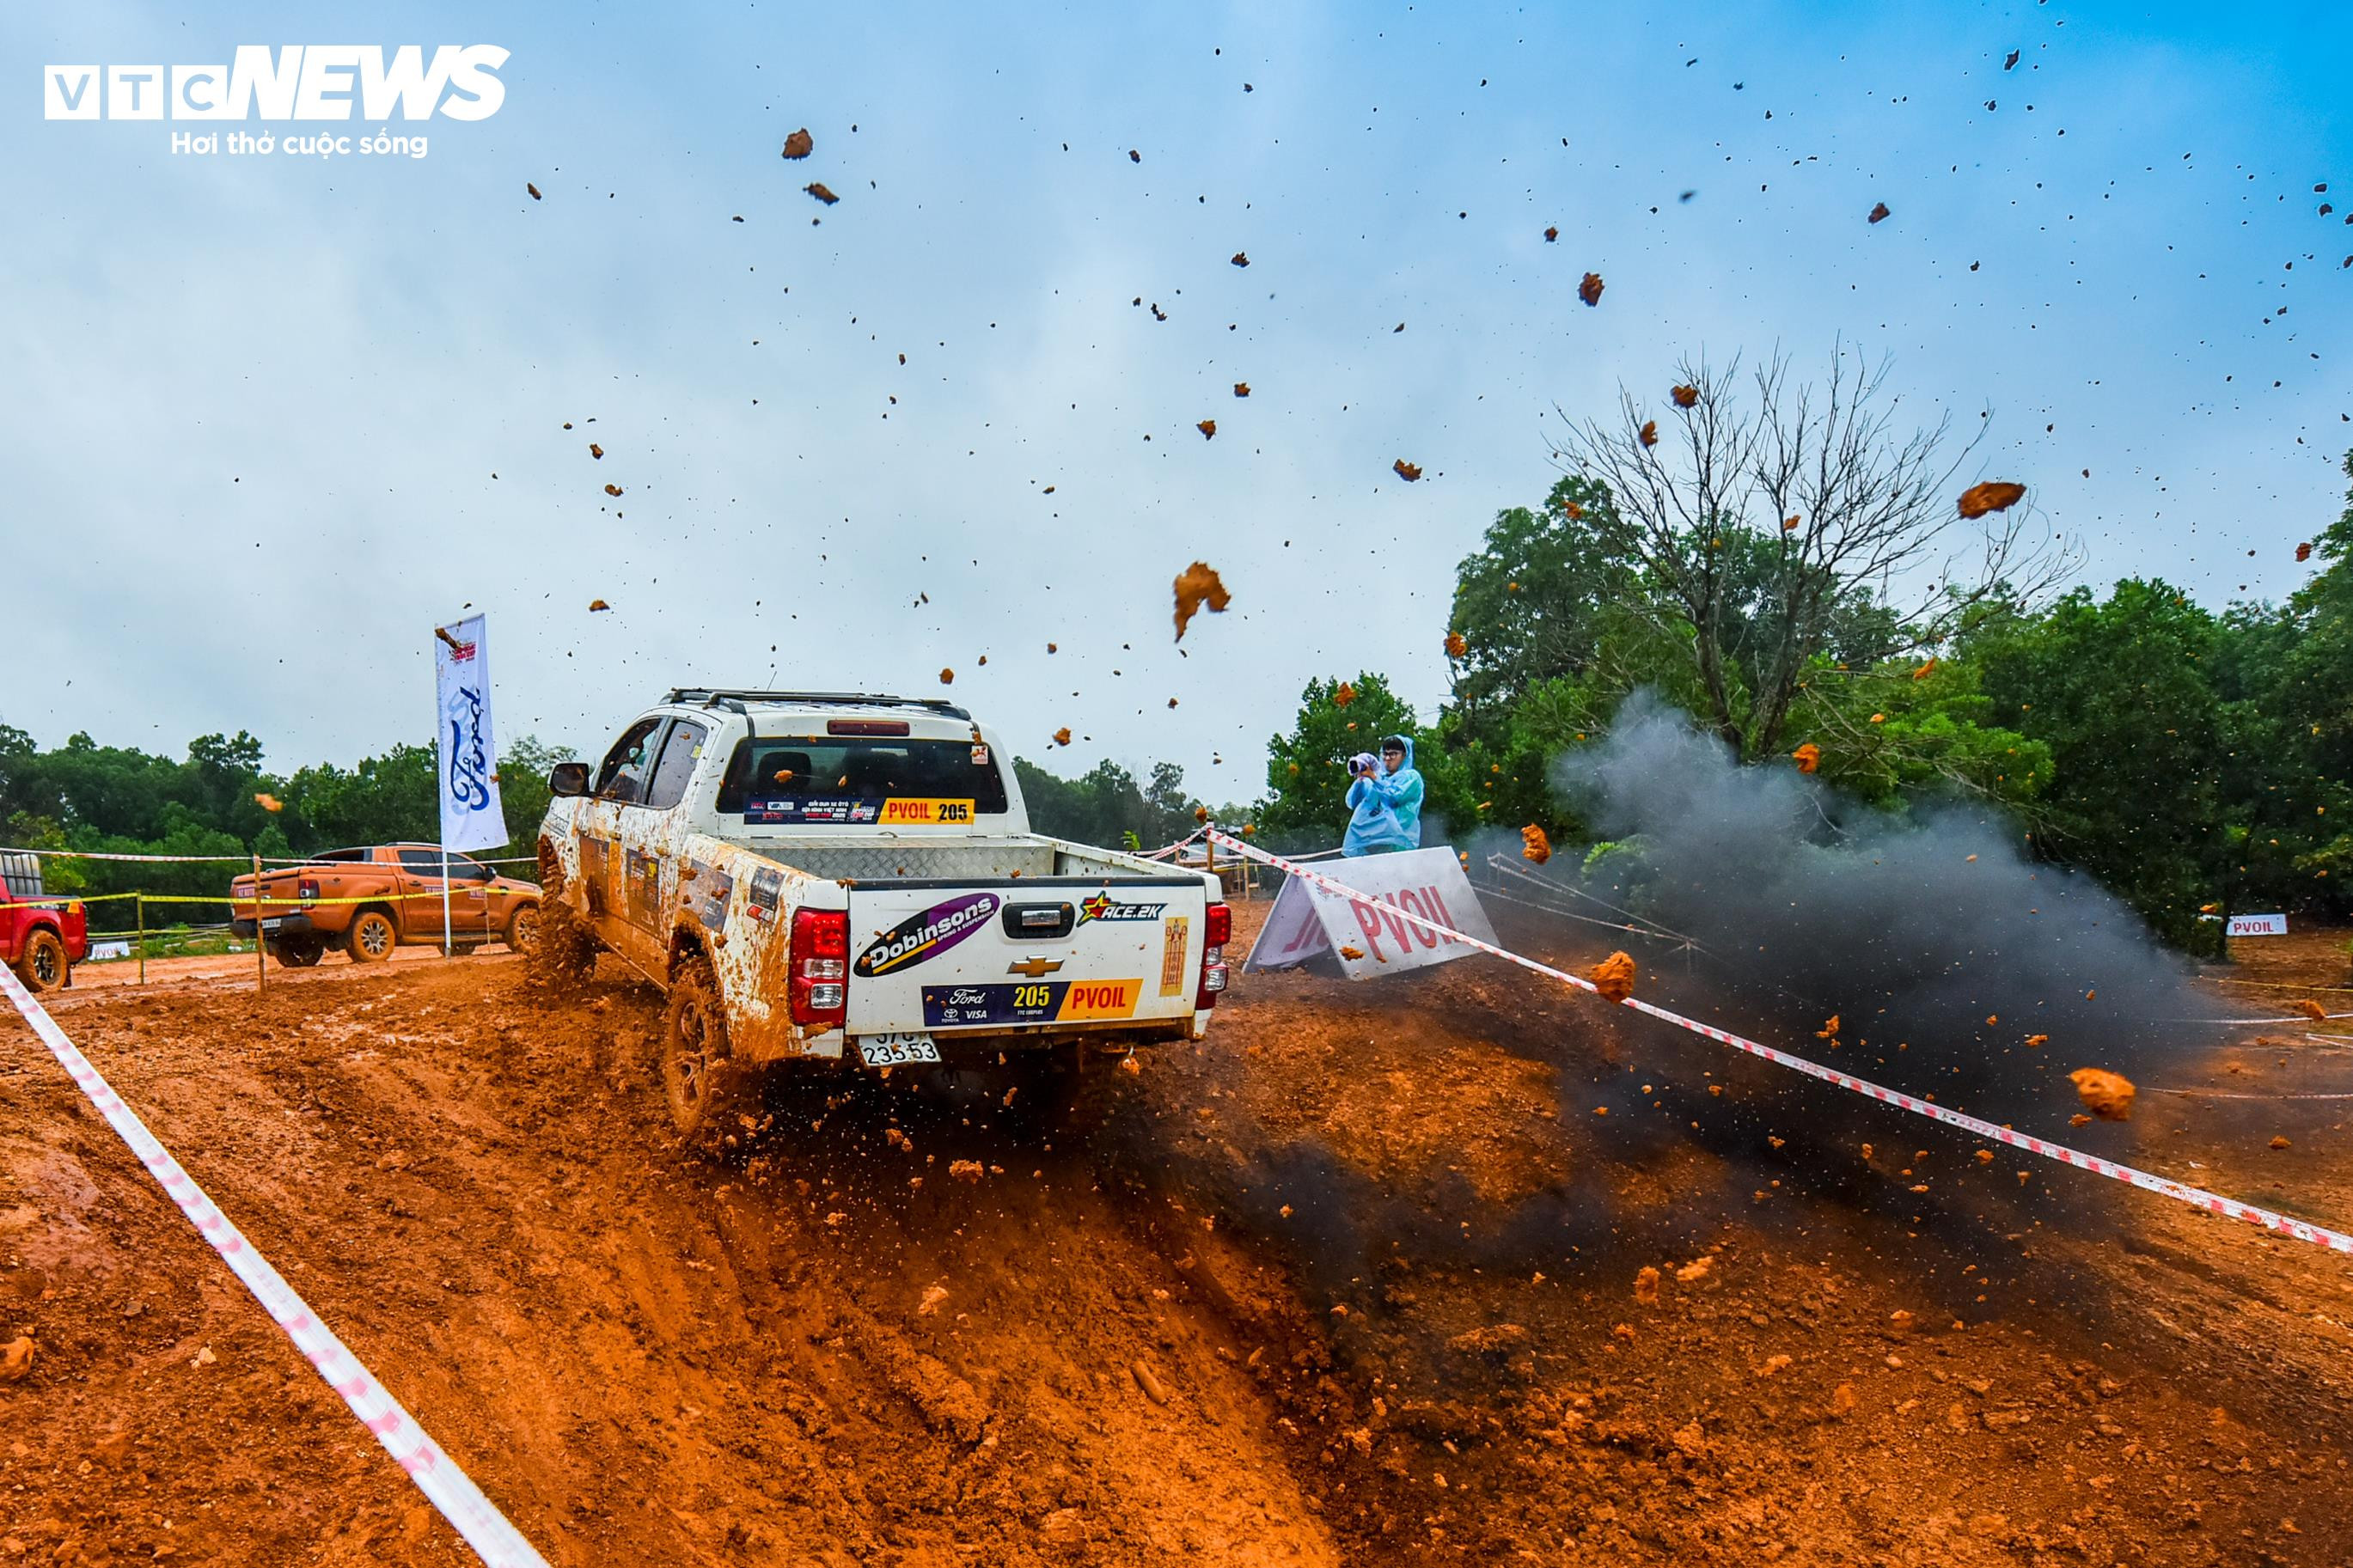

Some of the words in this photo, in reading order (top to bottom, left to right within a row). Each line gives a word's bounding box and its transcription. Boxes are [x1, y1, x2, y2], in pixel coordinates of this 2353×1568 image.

[451, 686, 490, 811] Ford
[889, 802, 931, 819] PVOIL
[938, 803, 968, 821] 205
[869, 897, 993, 968] Dobinsons
[2234, 921, 2274, 934] PVOIL
[949, 988, 986, 1005] Ford
[1013, 985, 1050, 1007] 205
[1072, 986, 1127, 1010] PVOIL
[965, 1009, 987, 1020] VISA
